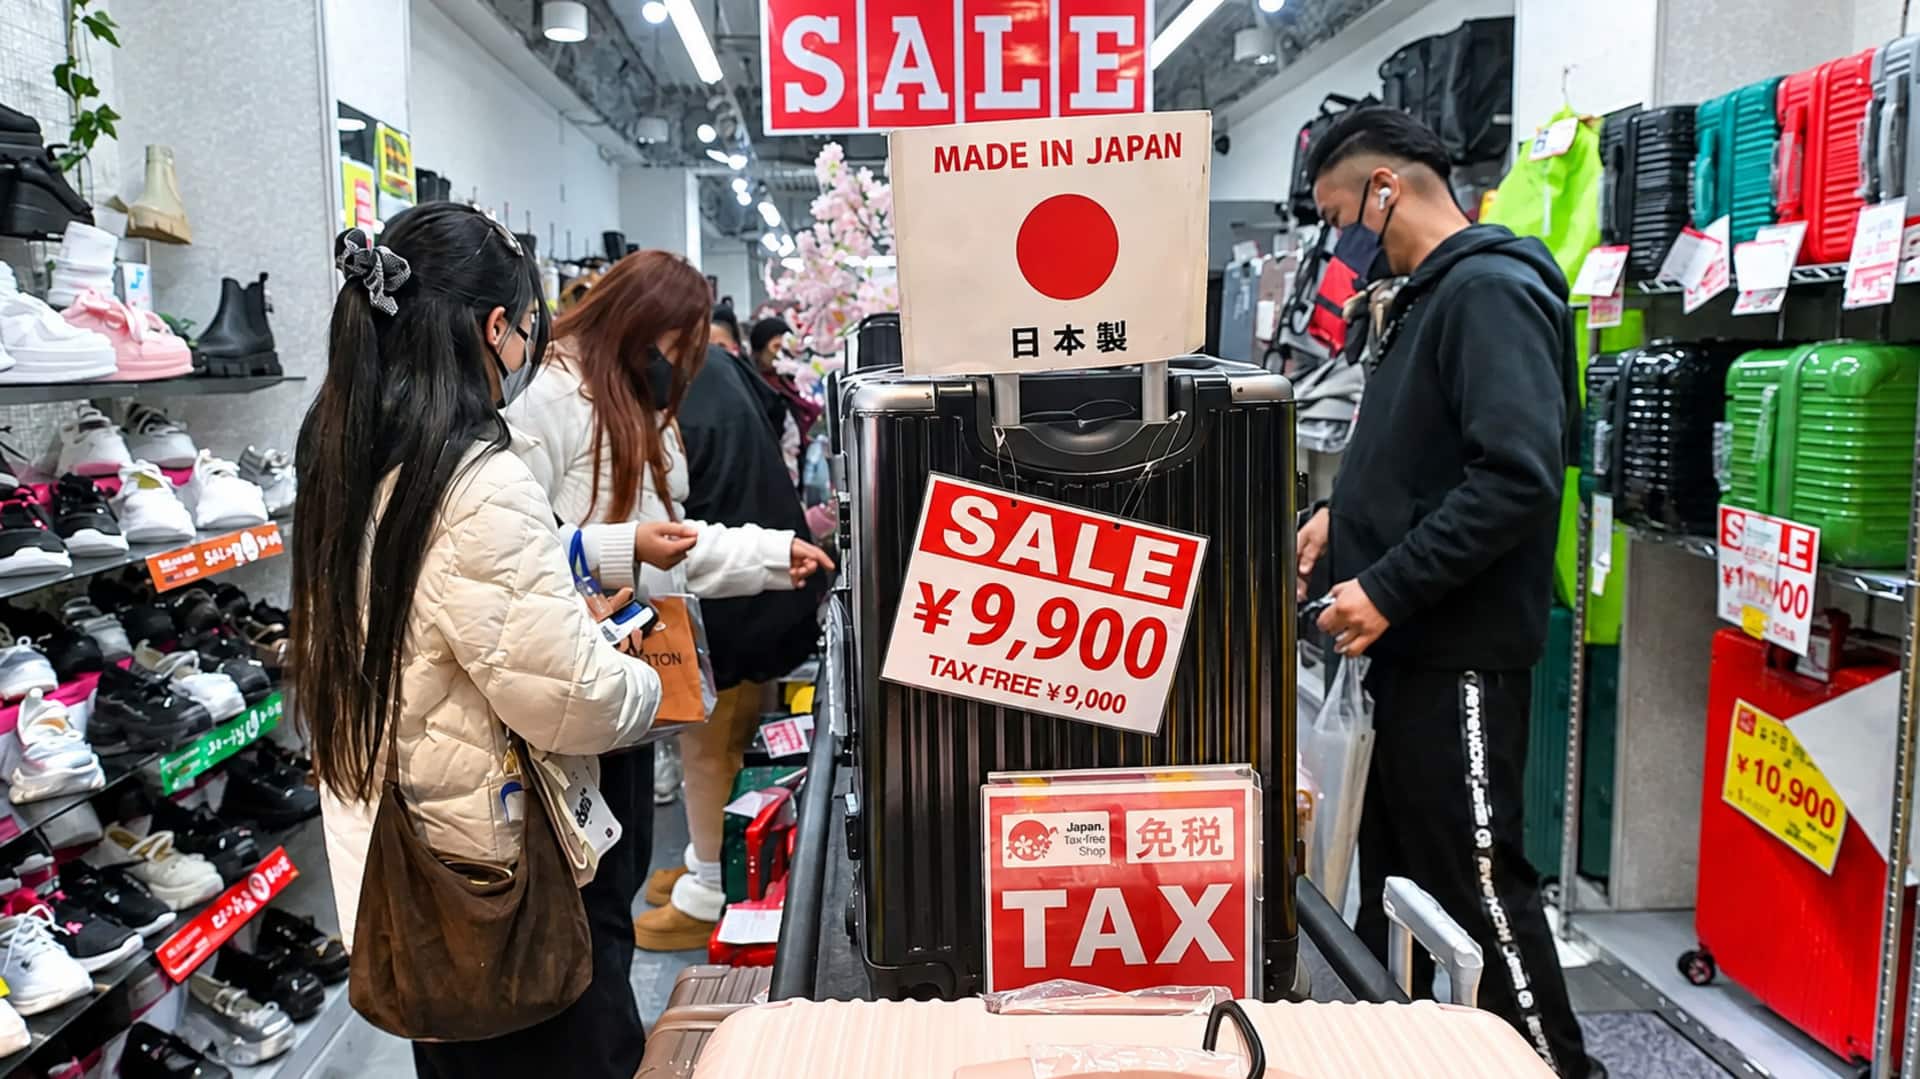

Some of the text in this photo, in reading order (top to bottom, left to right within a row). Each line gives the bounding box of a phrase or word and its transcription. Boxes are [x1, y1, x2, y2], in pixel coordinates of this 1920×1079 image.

[782, 16, 1135, 113] SALE
[934, 132, 1182, 173] MADE IN JAPAN
[1012, 320, 1127, 358] 日本製
[943, 495, 1180, 600] SALE
[1725, 512, 1810, 570] SE
[928, 654, 977, 684] TAX
[980, 667, 1042, 698] FREE
[1064, 834, 1106, 845] Tax-free
[1079, 846, 1106, 858] Shop
[1136, 815, 1224, 859] 免税
[1002, 883, 1235, 968] TAX
